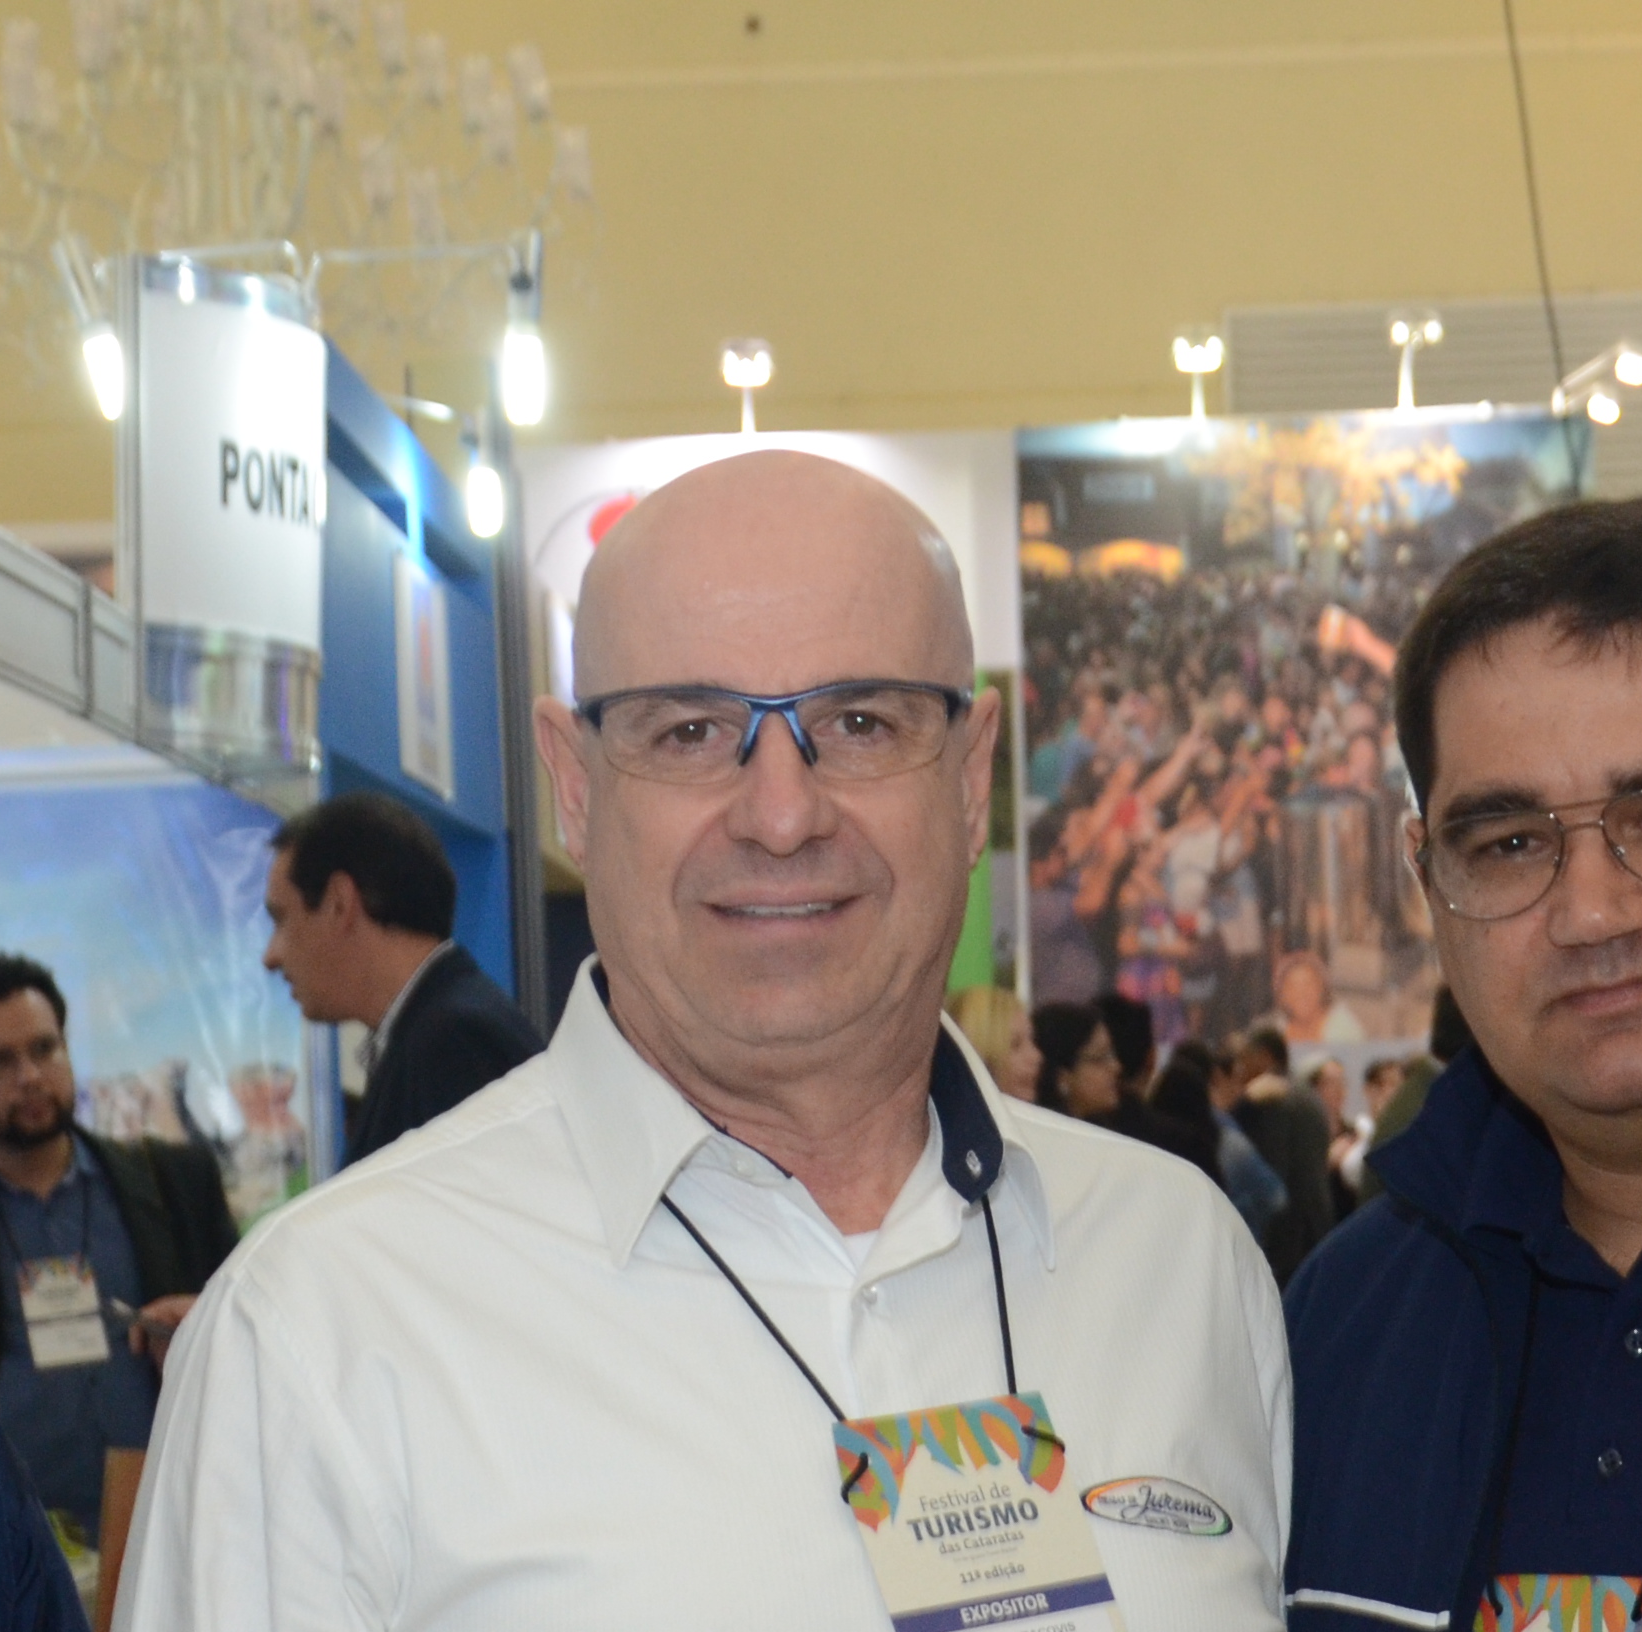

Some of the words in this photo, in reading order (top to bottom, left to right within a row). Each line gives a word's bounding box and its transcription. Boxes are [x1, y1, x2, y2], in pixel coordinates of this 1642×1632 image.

[219, 436, 309, 525] PONTA
[919, 1485, 986, 1512] Festival
[990, 1482, 1012, 1499] de
[906, 1497, 1039, 1541] TURISMO
[939, 1541, 962, 1555] das
[964, 1530, 1024, 1549] Cataratas
[984, 1562, 1025, 1581] edição
[960, 1592, 1050, 1623] EXPOSITOR
